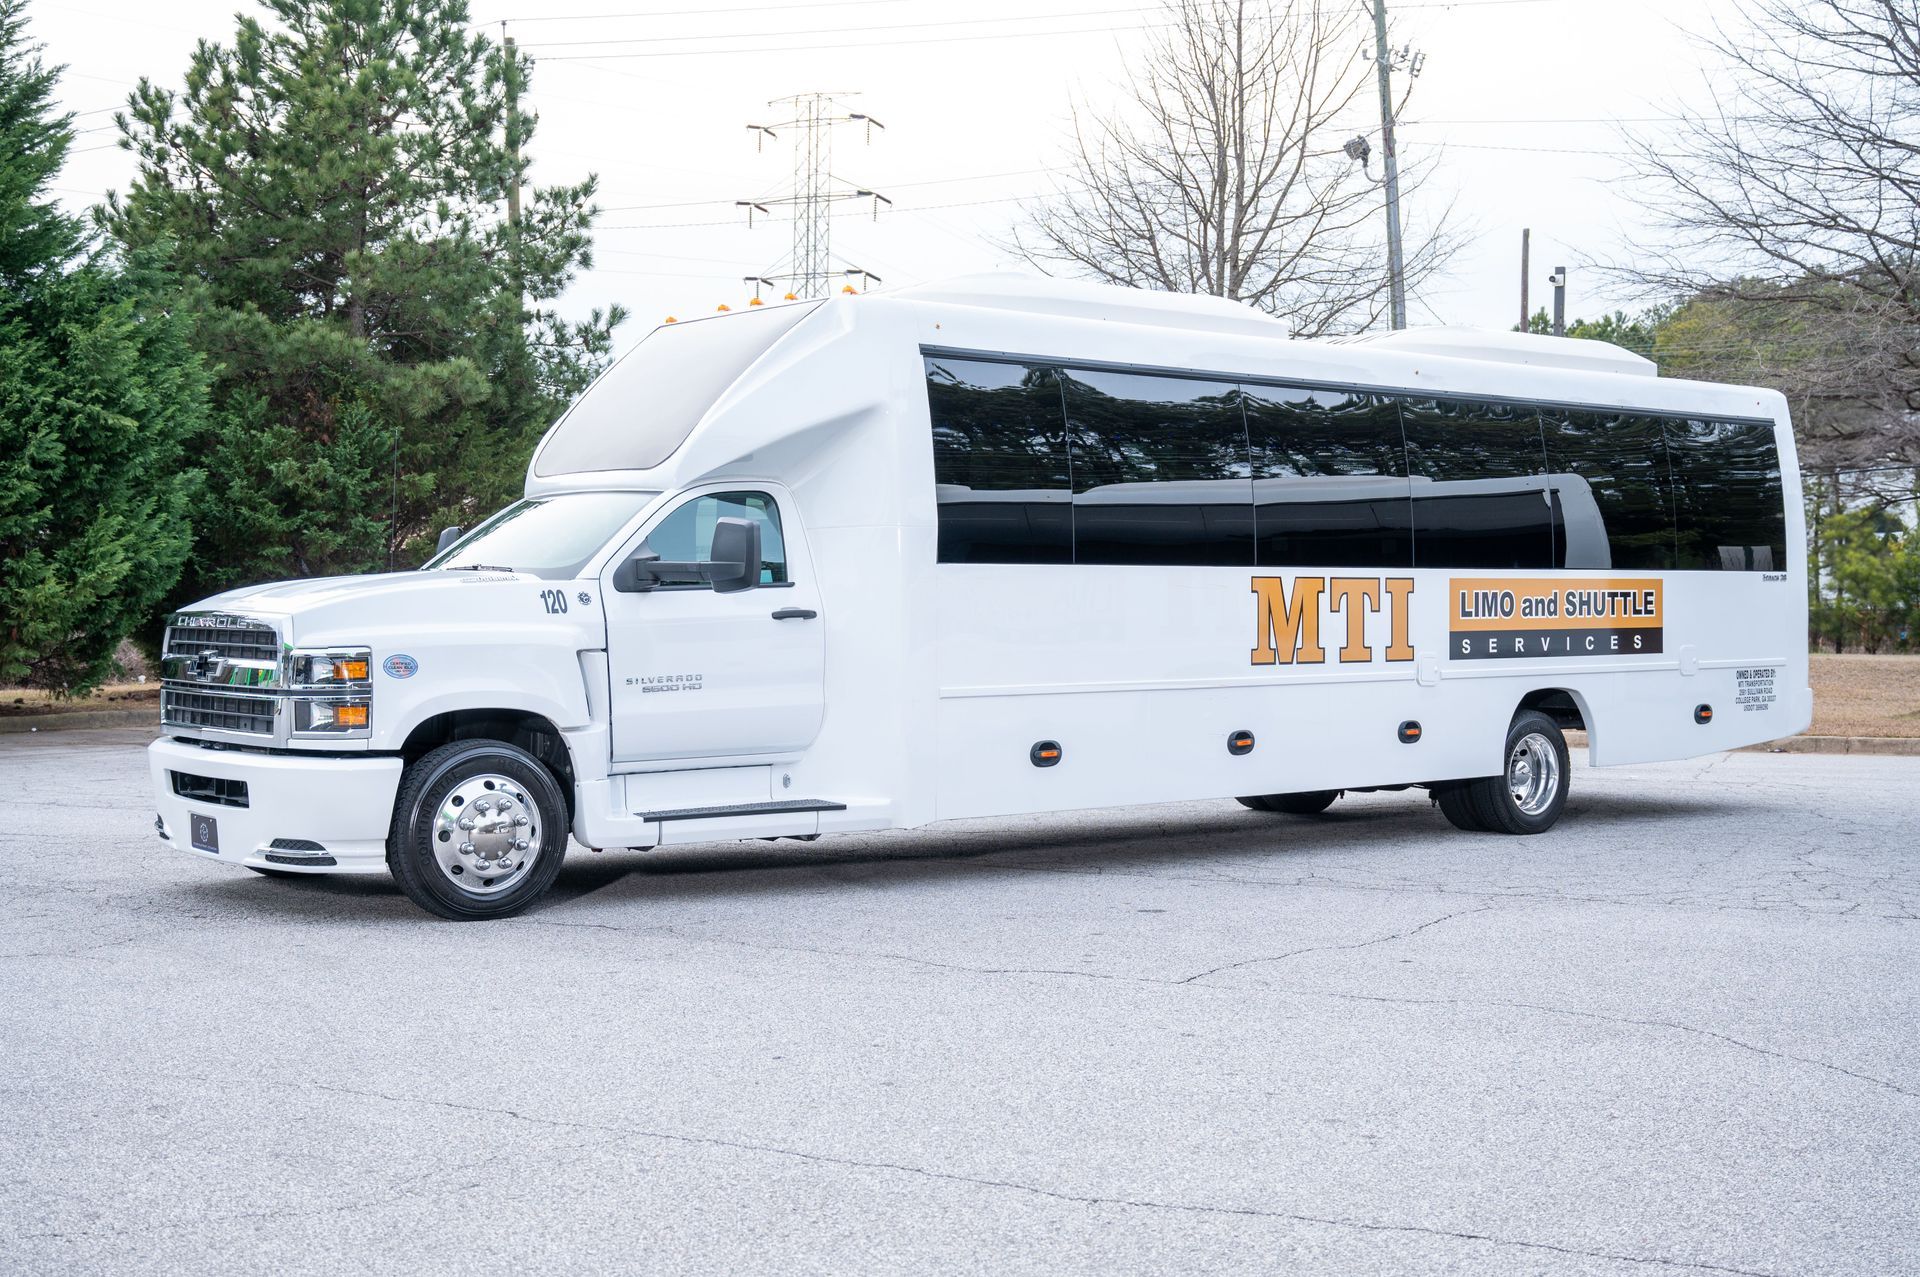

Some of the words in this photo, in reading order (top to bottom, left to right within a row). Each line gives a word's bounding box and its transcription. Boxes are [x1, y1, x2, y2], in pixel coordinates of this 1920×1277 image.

[540, 589, 568, 614] 120
[1459, 589, 1515, 619] LIMO
[1521, 589, 1559, 618] and
[1564, 588, 1656, 618] SHUTTLE
[1251, 576, 1414, 665] MTI
[1461, 634, 1642, 654] SERVICES
[626, 674, 702, 685] SILVERADO
[682, 683, 702, 691] HD
